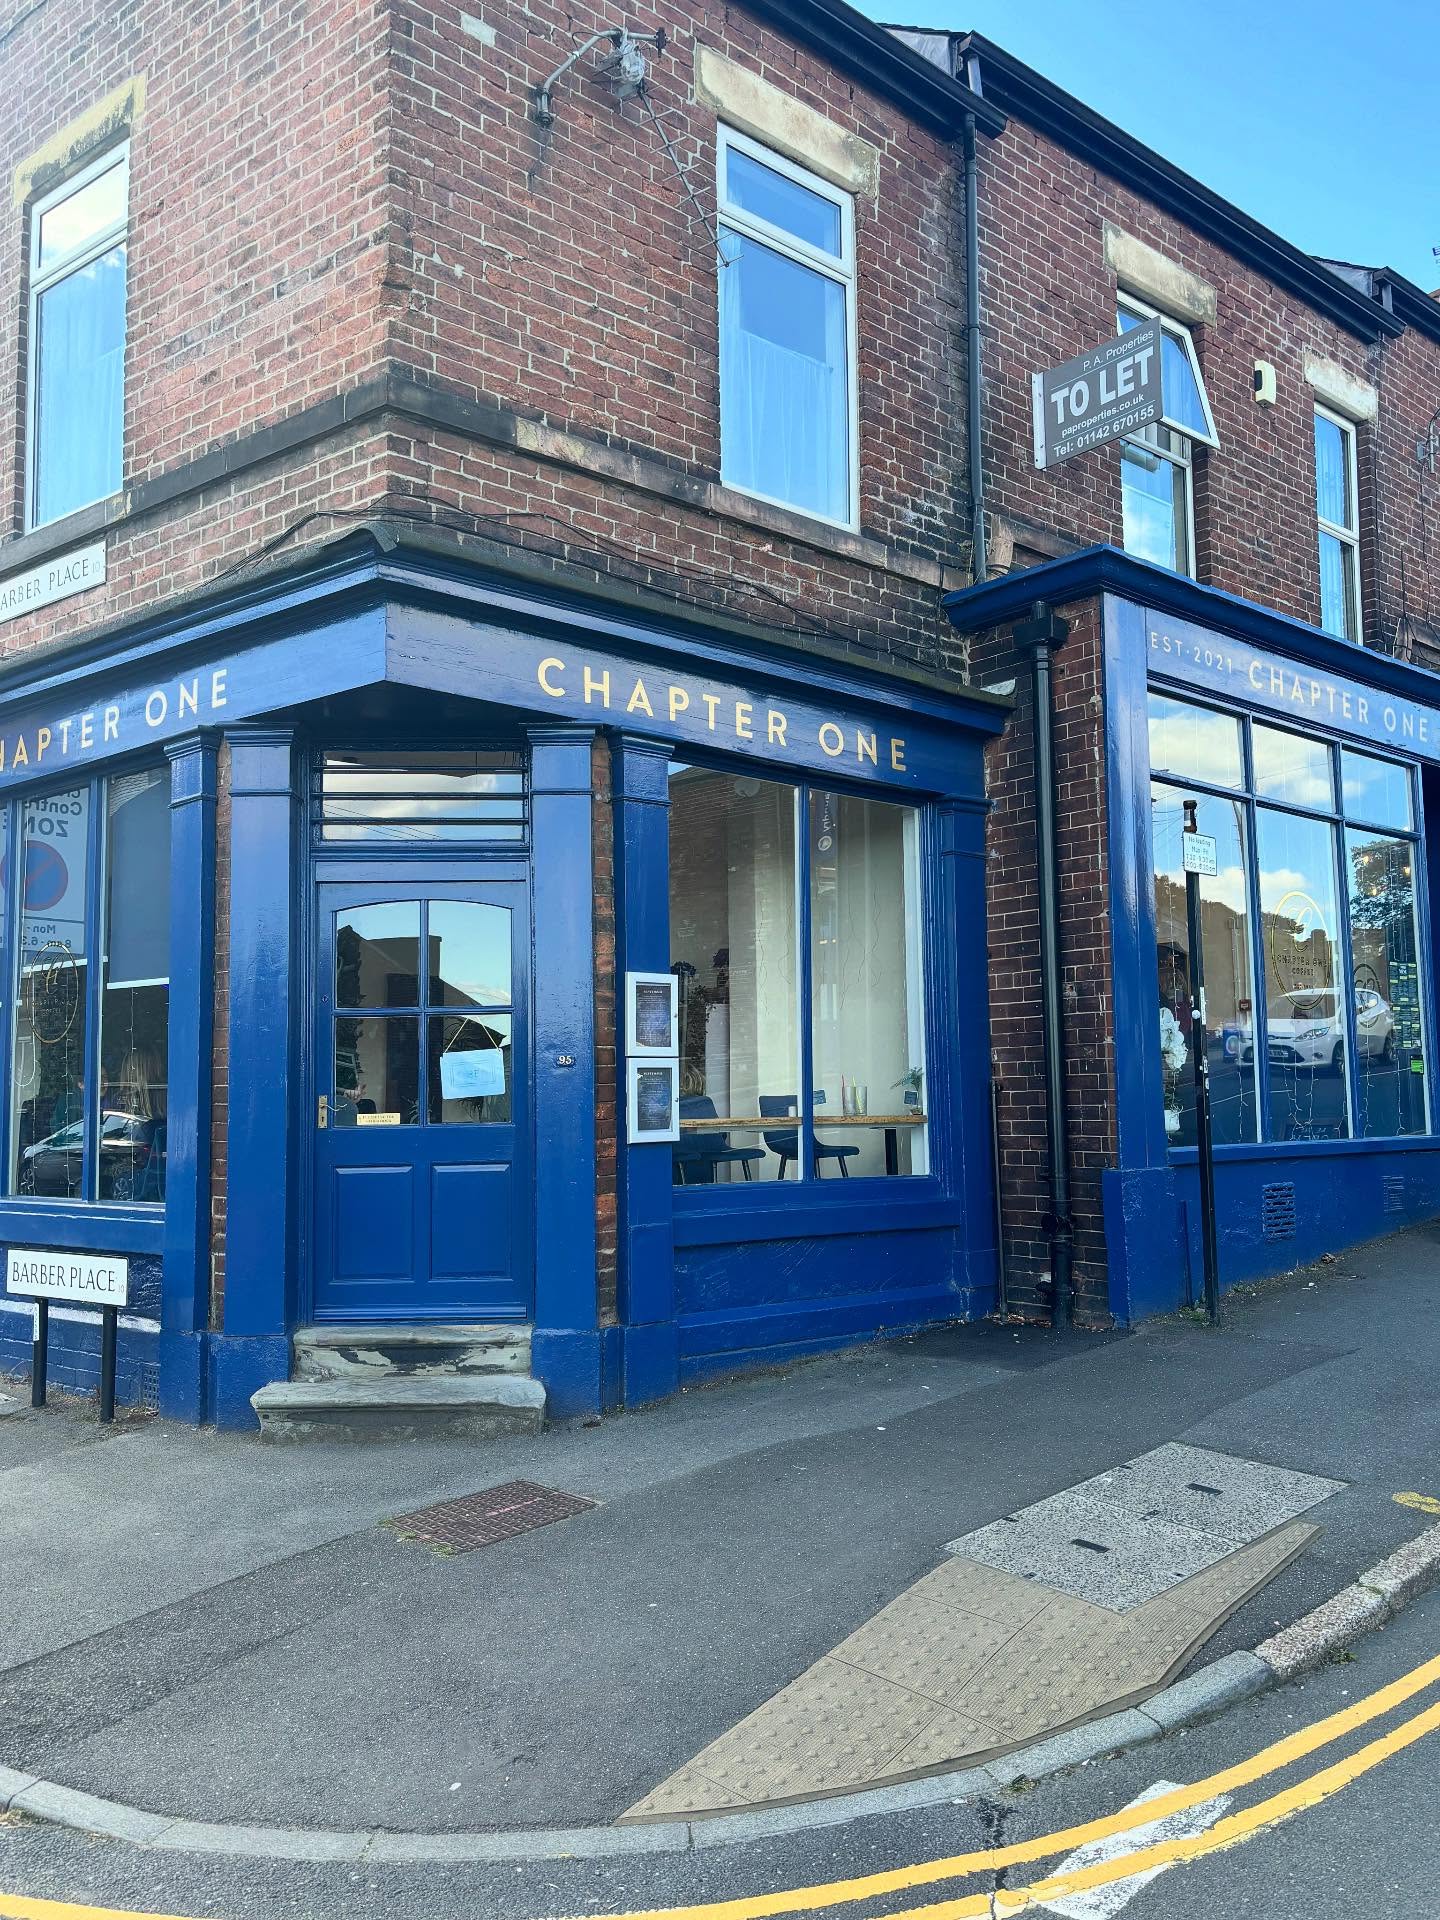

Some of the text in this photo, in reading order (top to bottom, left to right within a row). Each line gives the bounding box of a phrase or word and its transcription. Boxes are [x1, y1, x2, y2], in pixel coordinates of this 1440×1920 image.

[1083, 330, 1154, 372] P. A. Properties
[1051, 346, 1154, 425] TO LET
[1054, 405, 1155, 458] Tel: 01142 670155
[1062, 394, 1145, 438] paproperties.co.uk
[0, 578, 41, 610] ARBER
[49, 559, 89, 590] PLACE
[145, 669, 228, 727] ONE
[537, 657, 907, 771] CHAPTER ONE
[1248, 660, 1369, 724] CHAPTER
[1384, 708, 1428, 742] ONE
[558, 1055, 572, 1065] 95
[12, 1261, 66, 1287] BARBER
[70, 1266, 116, 1292] PLACE
